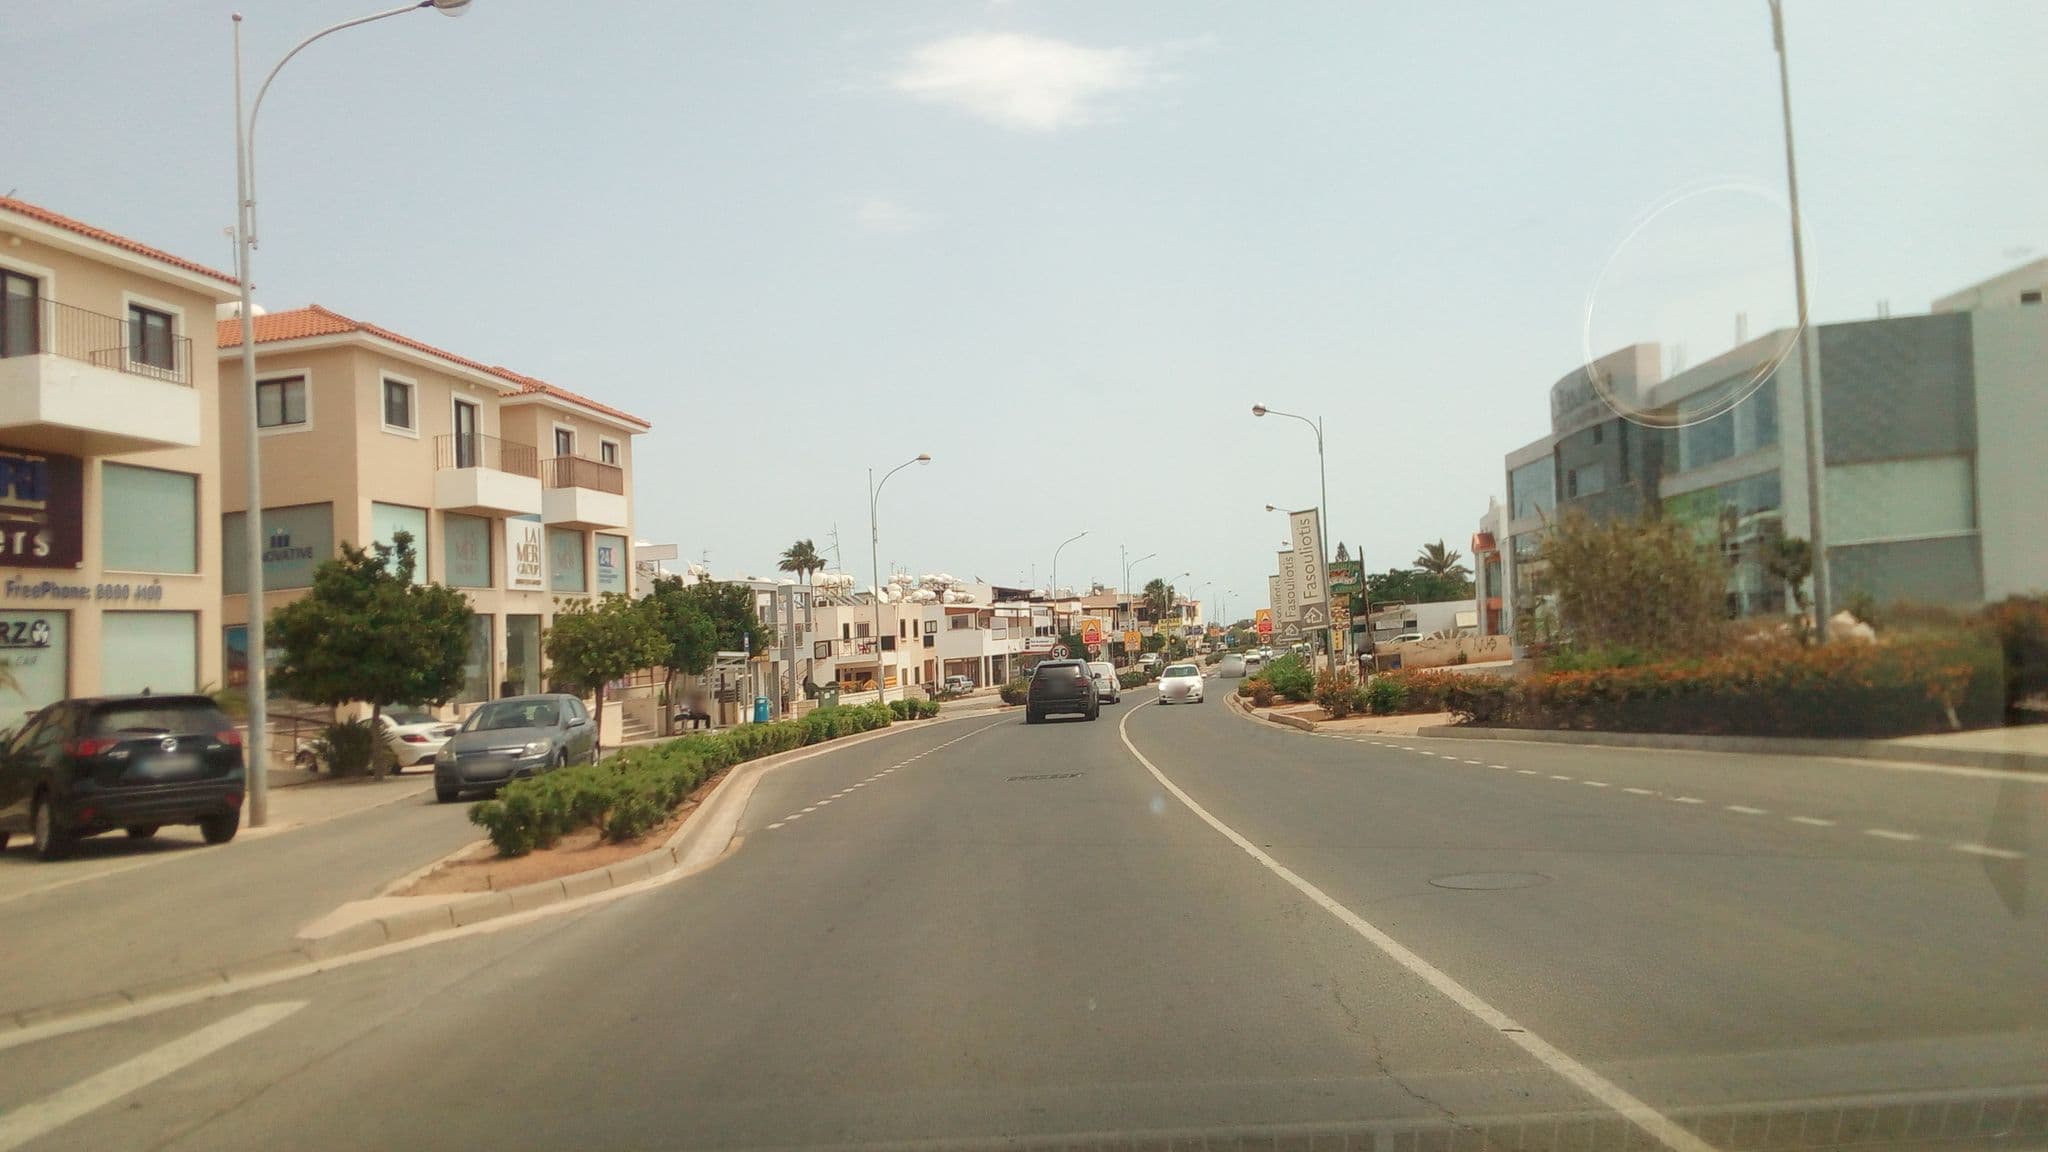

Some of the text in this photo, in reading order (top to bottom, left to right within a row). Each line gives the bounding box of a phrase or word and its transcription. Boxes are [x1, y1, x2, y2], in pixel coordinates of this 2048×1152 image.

[516, 542, 538, 562] MER
[1299, 517, 1318, 600] Fasouliotis
[1283, 556, 1296, 618] Fasouliotis
[1053, 648, 1067, 658] 50
